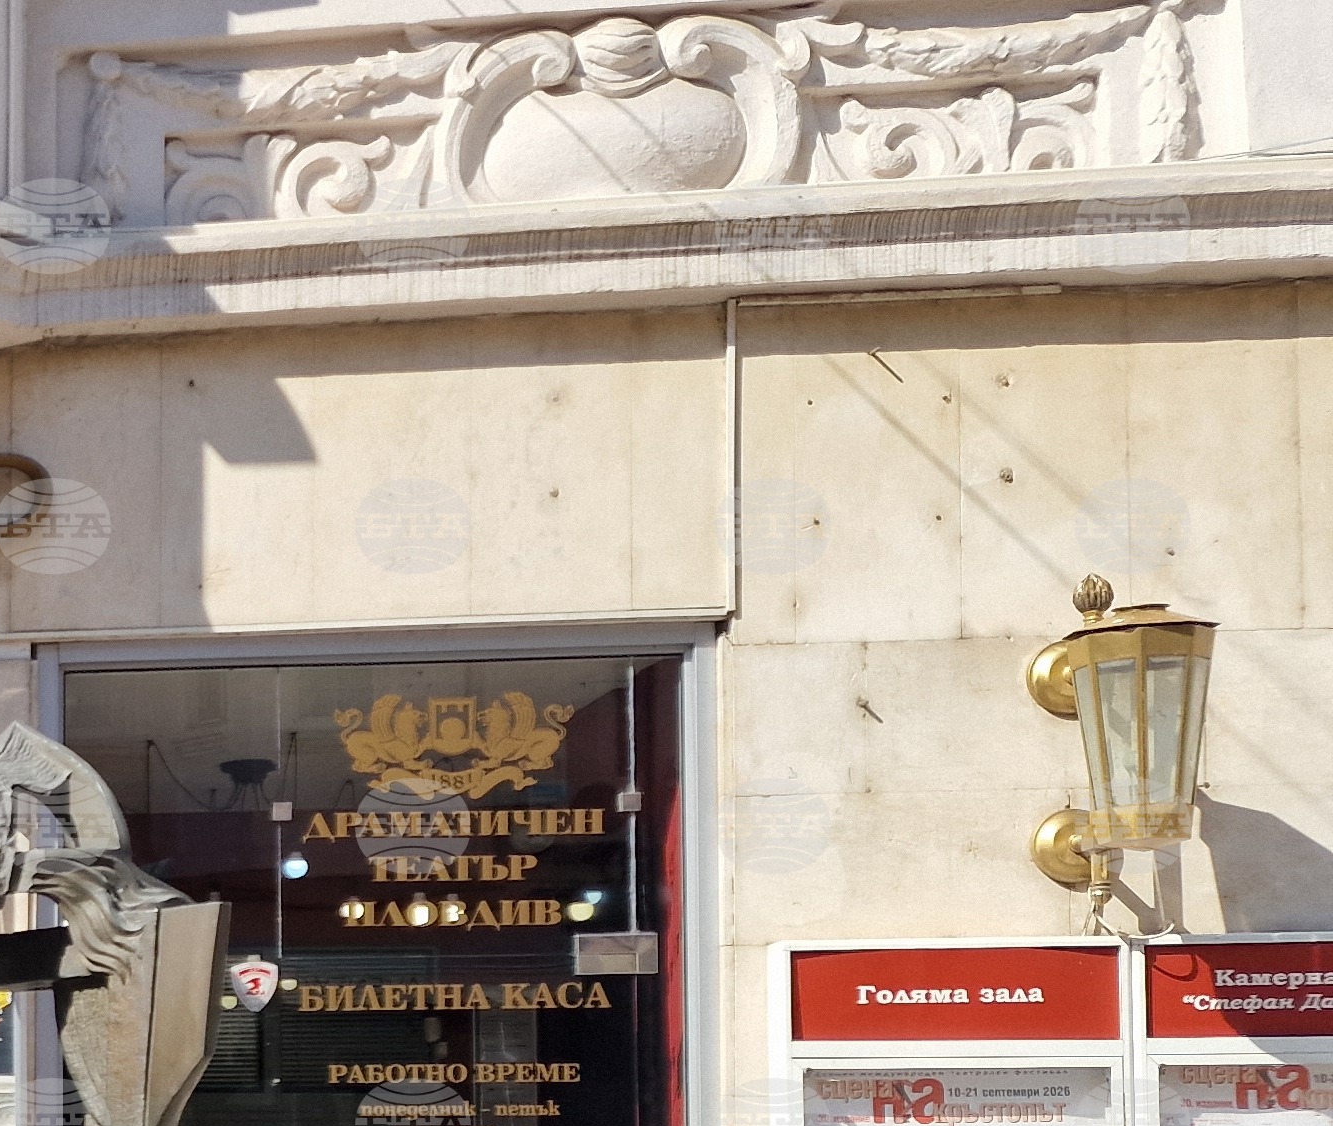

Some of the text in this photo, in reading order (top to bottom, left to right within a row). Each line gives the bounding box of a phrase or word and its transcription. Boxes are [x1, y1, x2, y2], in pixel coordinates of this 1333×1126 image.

[430, 773, 473, 789] 1881
[303, 808, 605, 843] ДРАМАТИЧЕН
[368, 854, 538, 883] ТЕАТЪР
[342, 899, 562, 931] ПЛОВДИВ
[298, 981, 612, 1012] БИЛЕТНА КАСА
[855, 984, 1045, 1006] Голяма зала
[328, 1062, 581, 1084] РАБОТНО ВРЕМЕ
[1180, 1065, 1257, 1088] сцена
[819, 1079, 893, 1103] сцена
[948, 1087, 978, 1098] 10-21
[982, 1087, 1040, 1099] септември
[358, 1100, 560, 1121] понеделник петък
